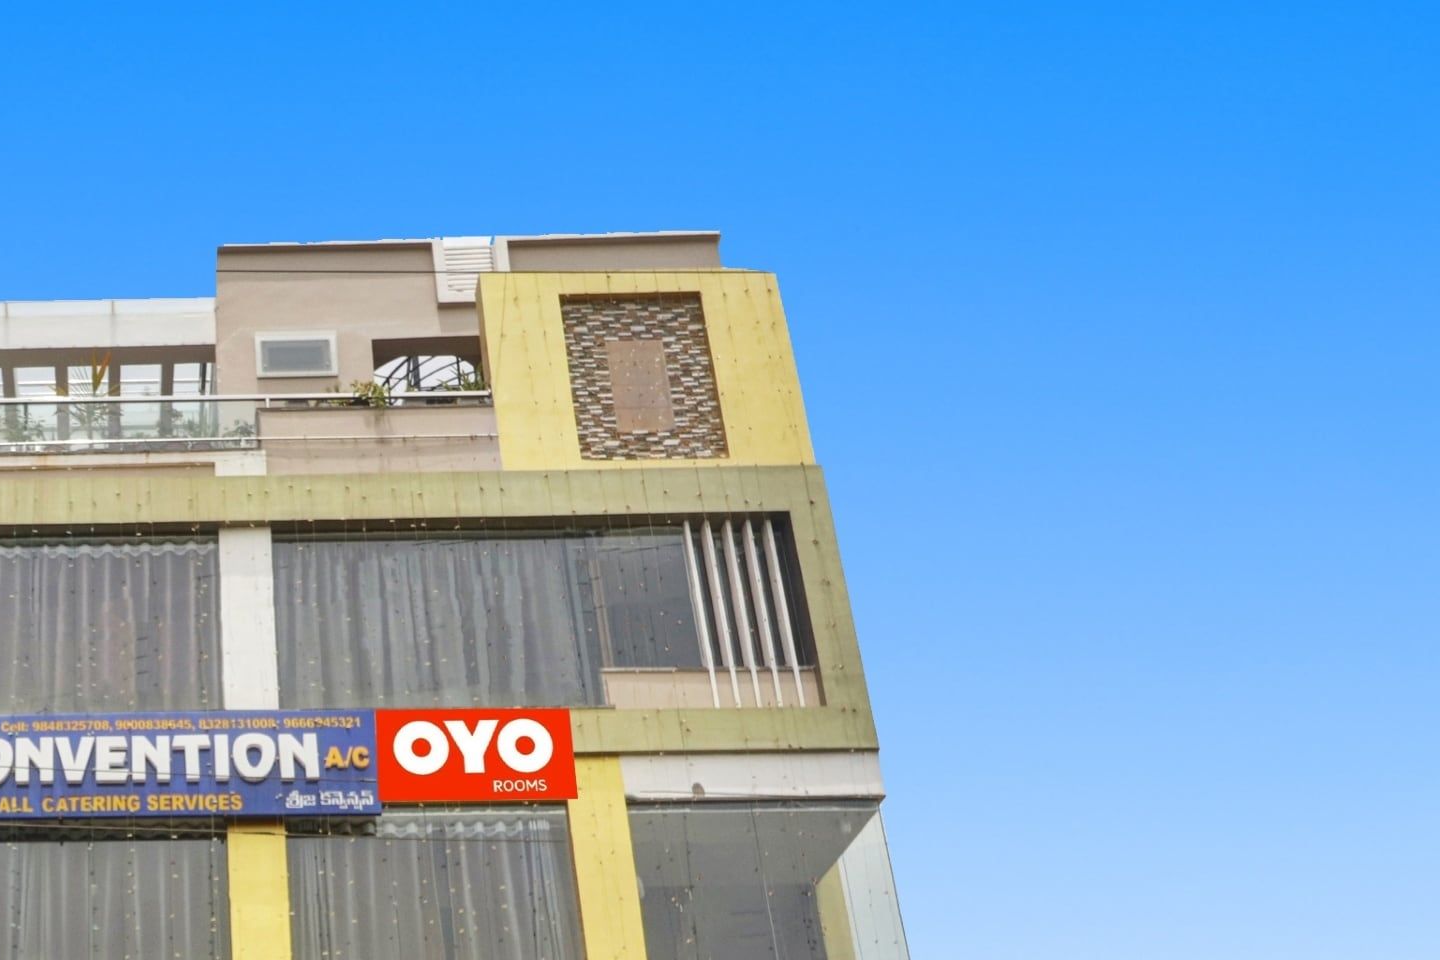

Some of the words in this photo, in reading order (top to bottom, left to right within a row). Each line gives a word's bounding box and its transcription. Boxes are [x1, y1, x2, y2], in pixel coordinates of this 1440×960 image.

[0, 721, 29, 732] Cell:
[393, 718, 553, 775] OYO
[324, 746, 370, 769] A/C
[493, 779, 548, 792] ROOMS
[42, 795, 141, 812] CATERING
[147, 794, 243, 812] SERVICES
